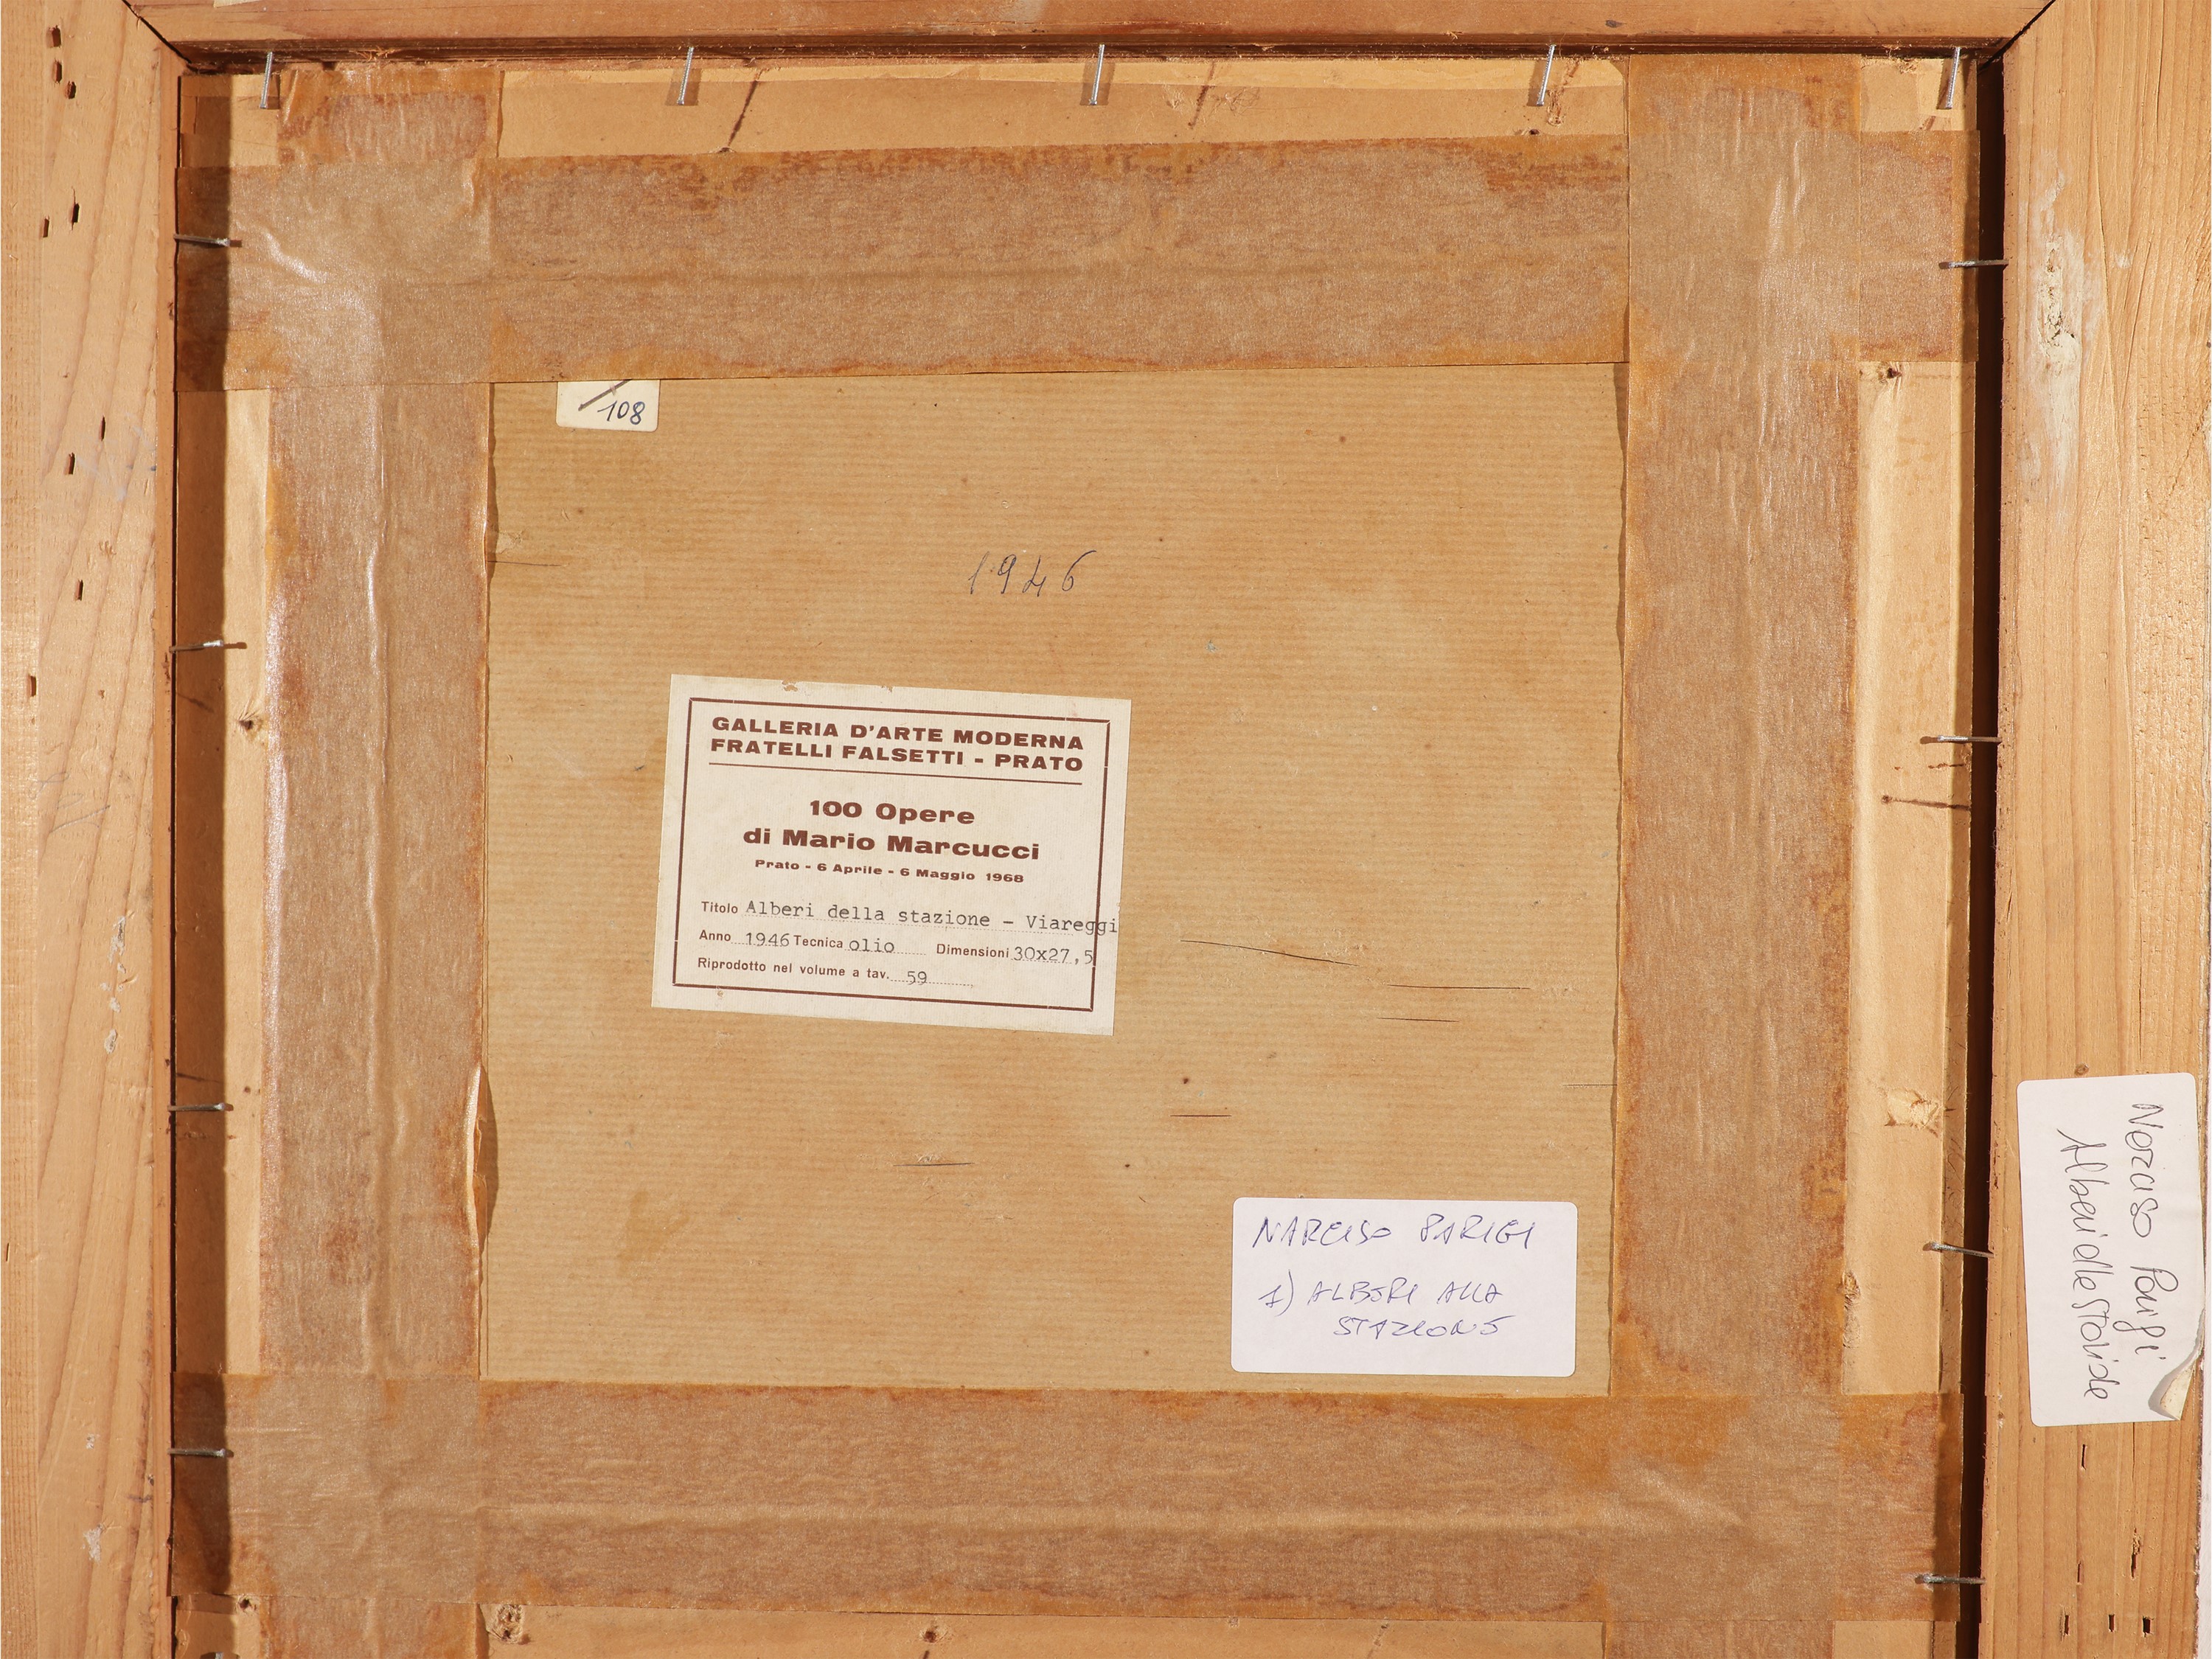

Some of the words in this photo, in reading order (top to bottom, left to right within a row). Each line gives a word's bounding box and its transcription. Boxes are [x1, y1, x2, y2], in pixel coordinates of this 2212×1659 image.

[597, 400, 645, 425] 108
[968, 551, 1096, 597] 1946
[712, 716, 839, 737] GALLERIA
[850, 724, 943, 742] D'ARTE
[953, 729, 1084, 750] MODERNA
[710, 738, 832, 758] FRATELLI
[842, 745, 964, 765] FALSETTI
[995, 754, 1083, 771] PRATO
[810, 799, 863, 818] 100
[875, 802, 975, 825] Opere
[742, 827, 771, 845] di
[782, 829, 876, 851] Mario
[887, 835, 1040, 860] Marcucci
[754, 859, 800, 871] Prato
[816, 863, 827, 872] 6
[832, 863, 883, 875] Aprile
[900, 867, 911, 877] 6
[916, 869, 975, 881] Maggio
[985, 872, 1024, 883] 1968
[701, 901, 738, 914] Titolo
[745, 900, 815, 918] Alberi
[827, 904, 885, 922] della
[898, 909, 990, 927] stazione
[1026, 914, 1118, 936] Viareggi
[699, 929, 731, 942] Anno
[745, 931, 790, 947] 1946
[793, 934, 844, 949] Tecnica
[849, 937, 895, 953] olio
[936, 943, 1010, 959] Dimensioni
[698, 957, 767, 972] Riprodotto
[773, 962, 793, 973] nel
[799, 964, 846, 977] volume
[852, 969, 860, 978] a
[866, 967, 890, 980] tav.
[907, 970, 928, 986] 59
[1253, 1215, 1392, 1248] NARCISO
[1420, 1213, 1536, 1250] PARIGI
